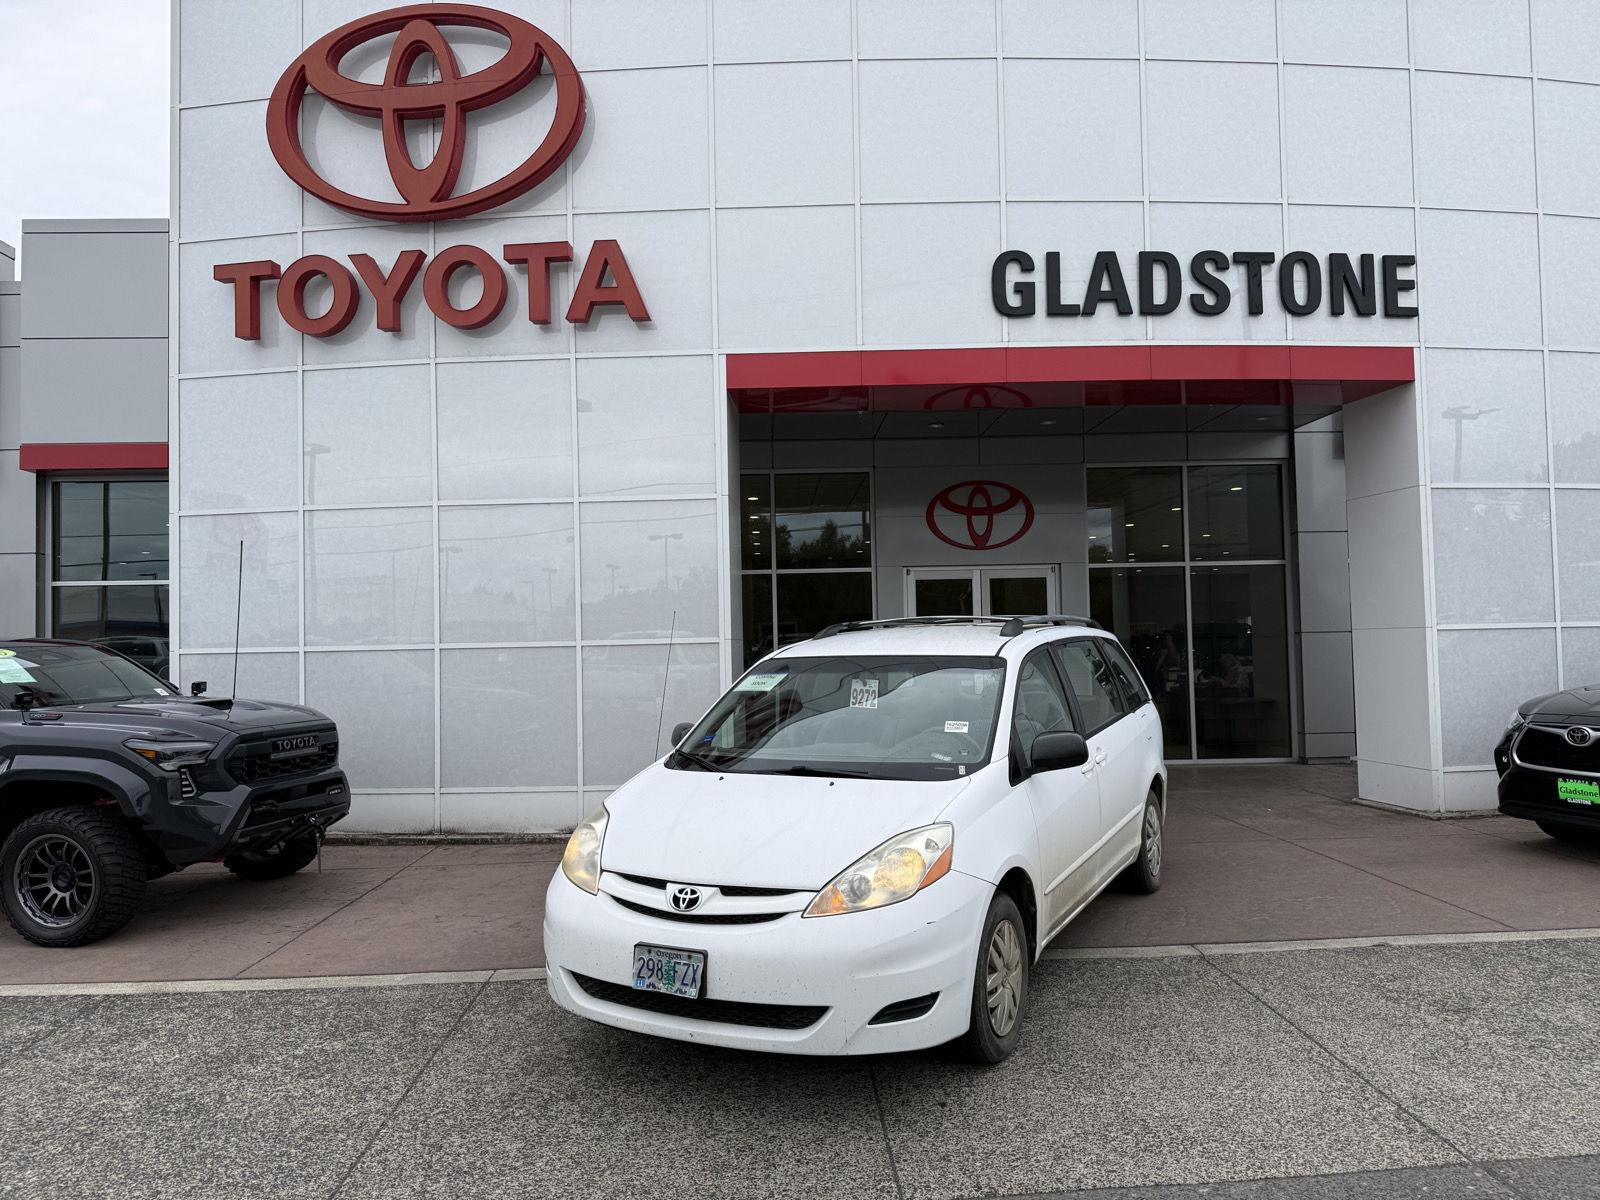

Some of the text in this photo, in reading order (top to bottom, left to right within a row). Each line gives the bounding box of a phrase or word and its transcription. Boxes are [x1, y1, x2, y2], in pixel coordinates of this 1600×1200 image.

[213, 239, 652, 341] TOYOTA
[991, 250, 1419, 318] GLADSTONE
[851, 688, 877, 708] 9272
[277, 736, 316, 751] TOYOTA
[1559, 786, 1599, 797] Gladstone
[656, 950, 682, 960] Oregon
[637, 956, 700, 988] 298 FZX
